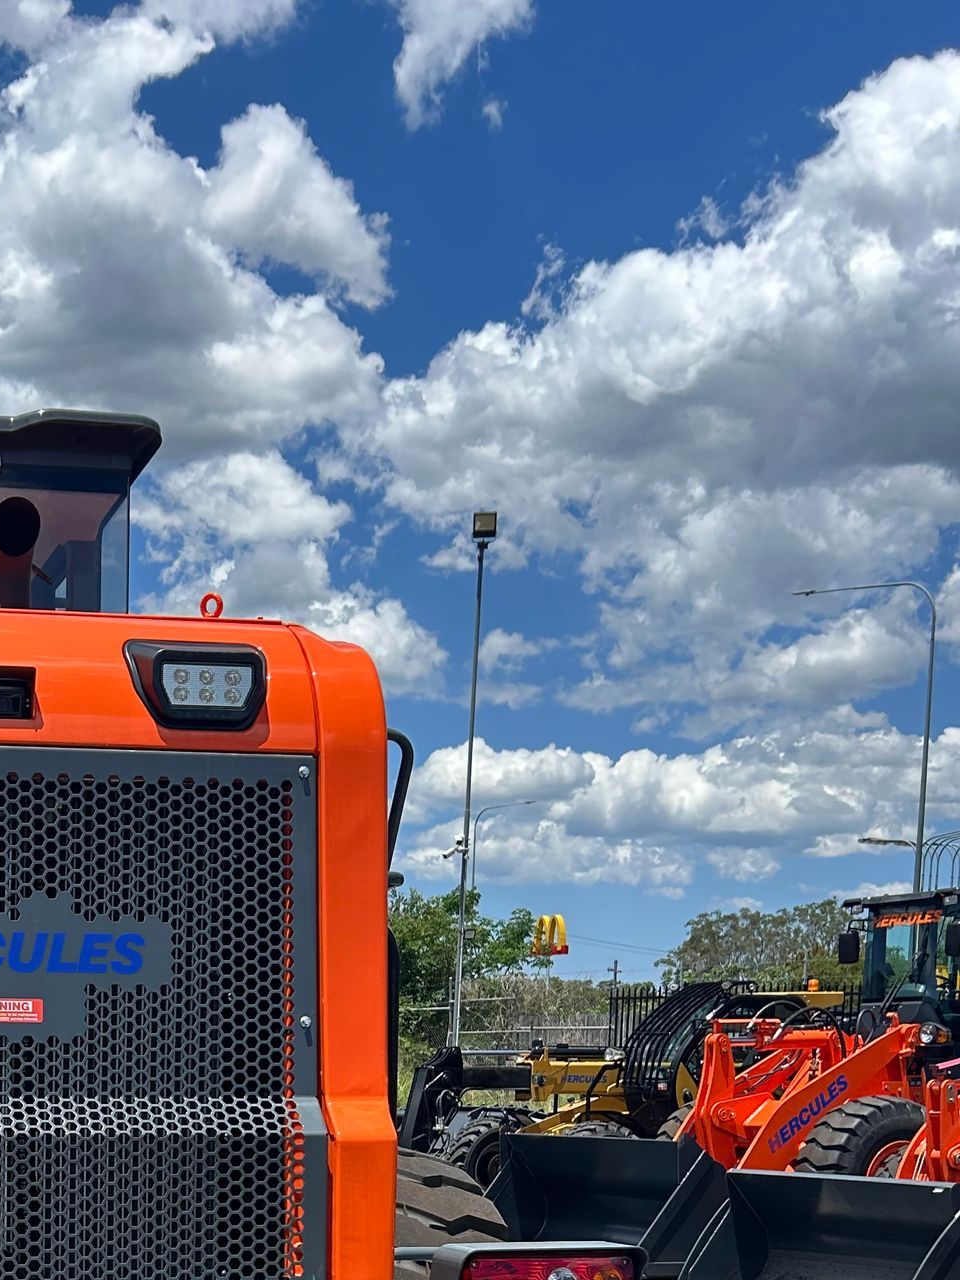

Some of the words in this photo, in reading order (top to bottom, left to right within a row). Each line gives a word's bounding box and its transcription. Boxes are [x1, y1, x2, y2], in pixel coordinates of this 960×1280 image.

[874, 909, 943, 928] HERCULES
[561, 1074, 608, 1083] HERCUS
[768, 1074, 848, 1153] HERCULES
